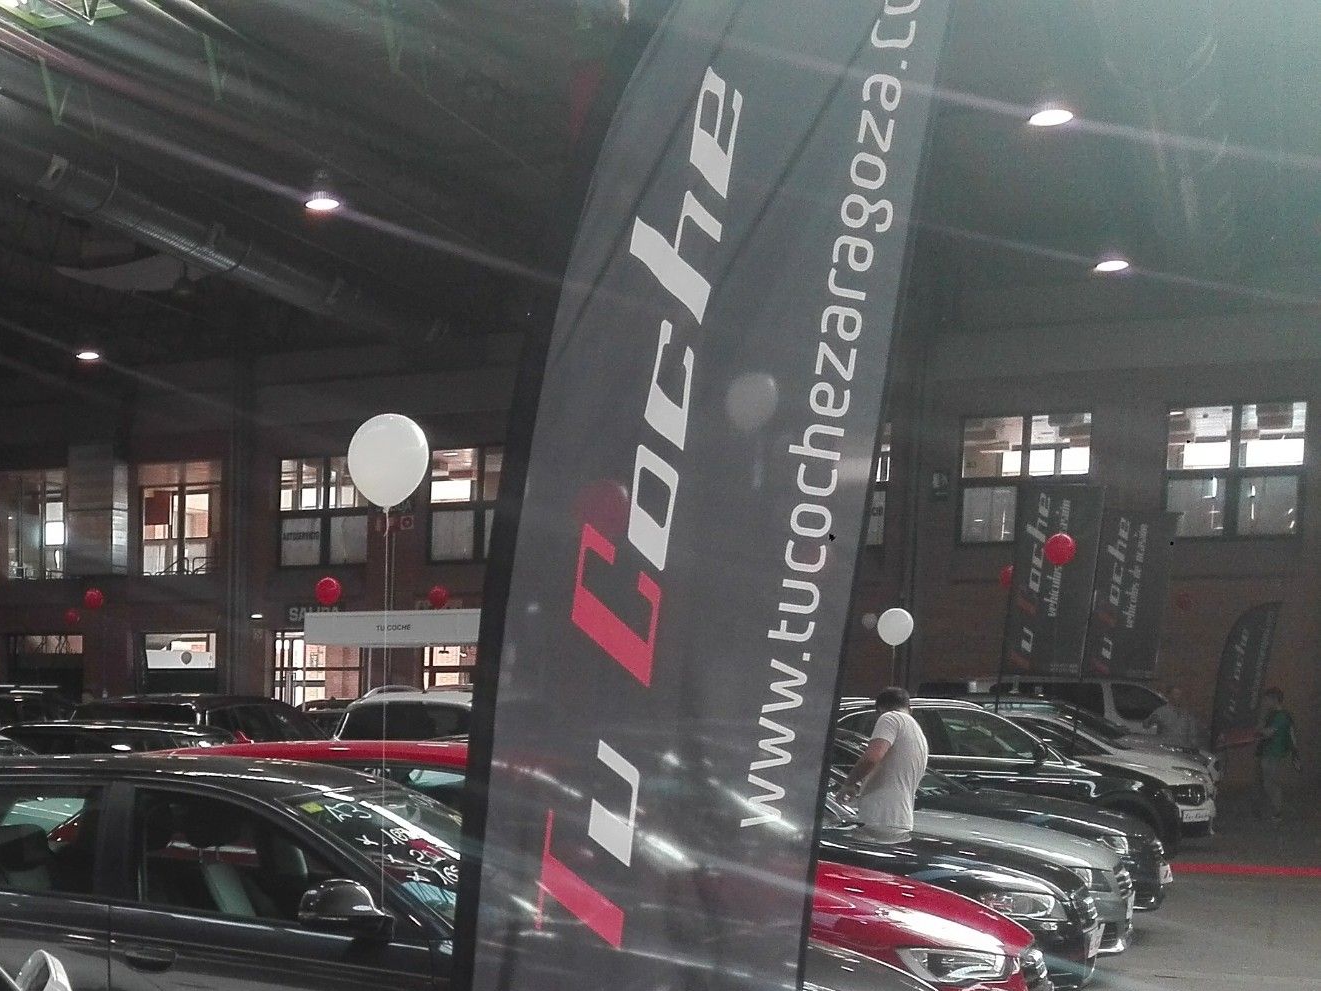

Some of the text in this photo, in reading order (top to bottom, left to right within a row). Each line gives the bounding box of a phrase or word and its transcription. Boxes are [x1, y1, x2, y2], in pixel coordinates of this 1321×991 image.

[387, 624, 411, 632] COCHE
[535, 65, 744, 950] Tu Coche
